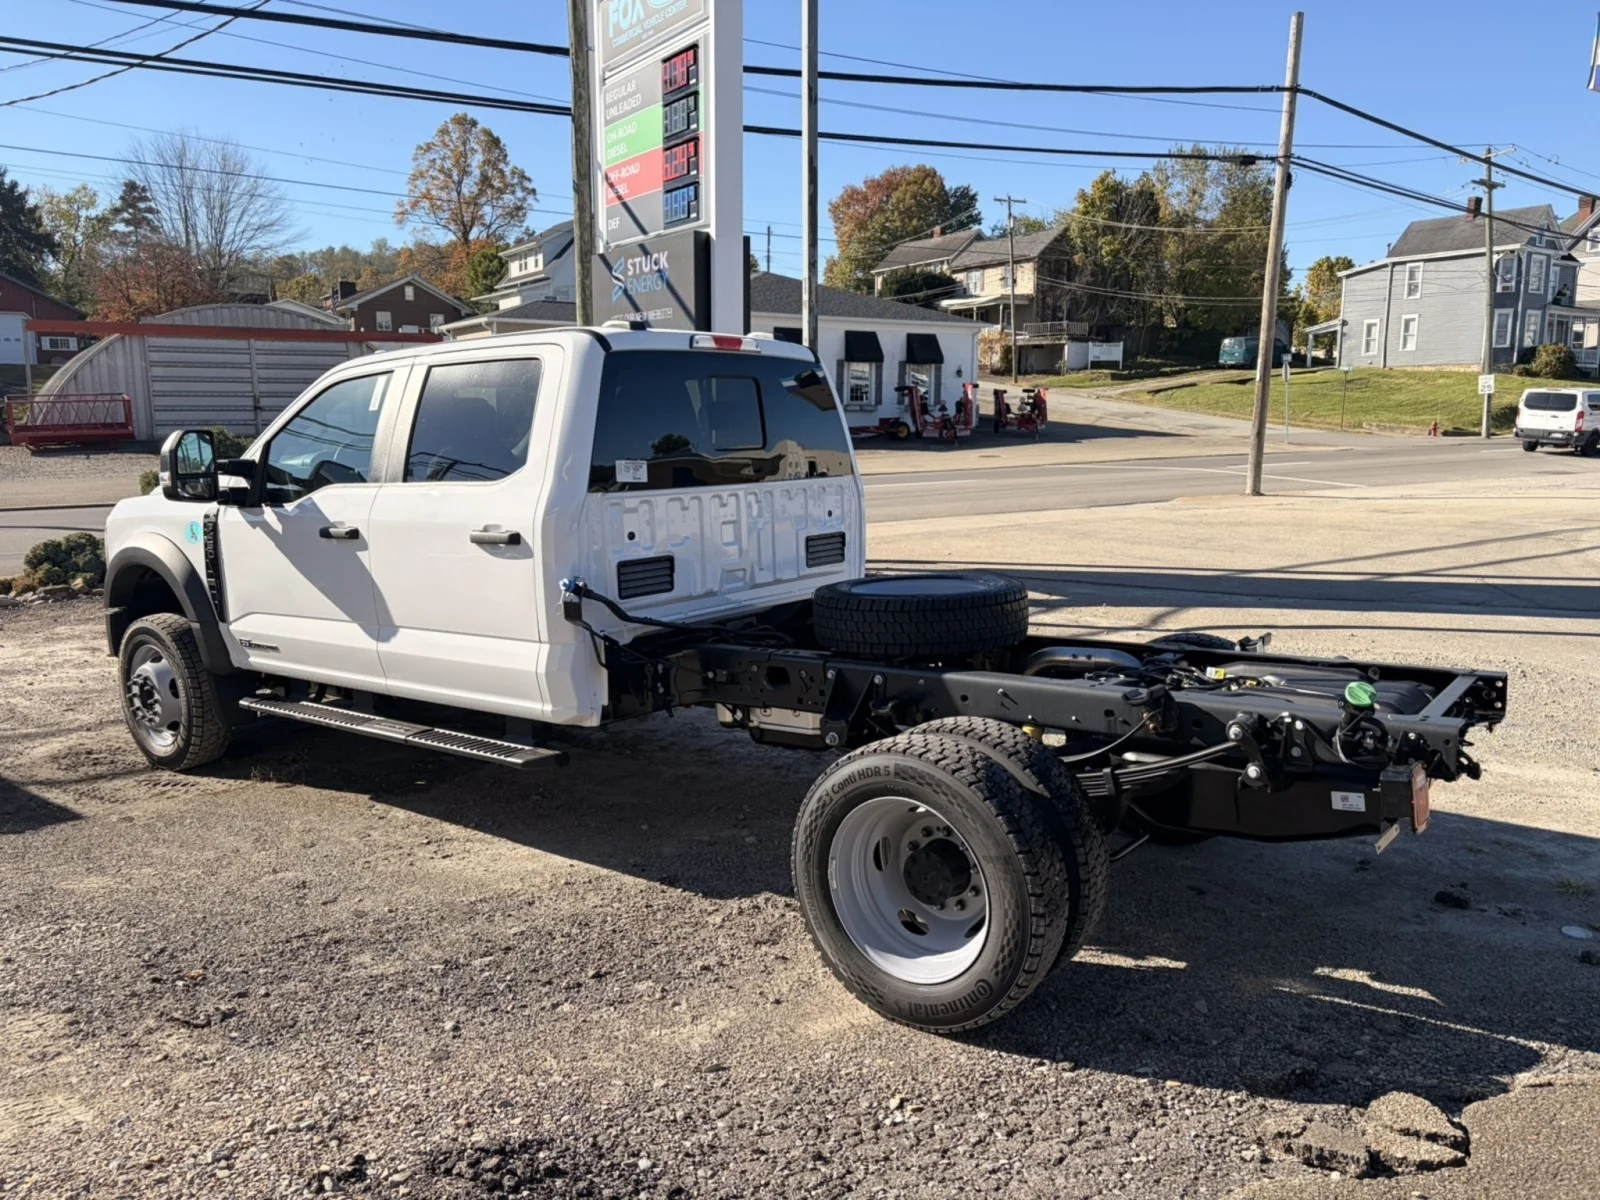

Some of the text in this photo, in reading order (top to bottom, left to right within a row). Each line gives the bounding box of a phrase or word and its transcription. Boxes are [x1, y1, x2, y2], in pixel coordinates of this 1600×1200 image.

[606, 79, 637, 104] REGULAR
[606, 93, 642, 120] UNLEADED
[607, 122, 638, 144] ON-ROAD
[607, 143, 628, 159] DIESEL
[607, 162, 641, 183] OFF-ROAD
[608, 217, 620, 230] DEF
[627, 250, 669, 276] STUCK
[627, 271, 669, 294] ENERGY
[1480, 384, 1493, 392] 25
[831, 765, 891, 795] Conti HDR 5
[907, 979, 994, 1018] Continental
